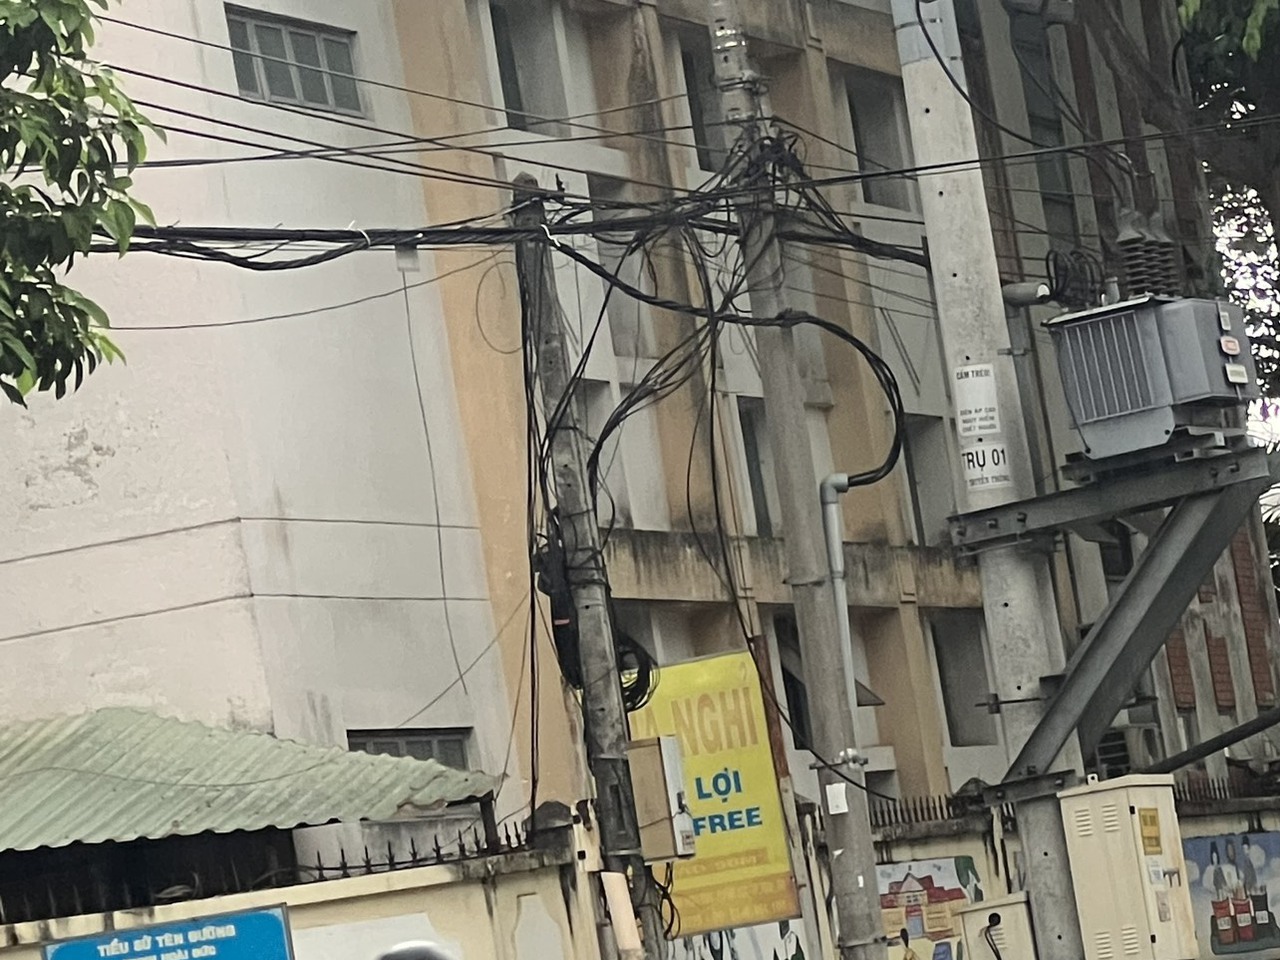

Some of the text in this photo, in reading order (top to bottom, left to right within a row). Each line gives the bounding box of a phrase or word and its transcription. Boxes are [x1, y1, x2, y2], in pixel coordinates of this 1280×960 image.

[991, 448, 1006, 466] 01
[692, 807, 763, 836] FREE
[156, 933, 183, 948] TÊN
